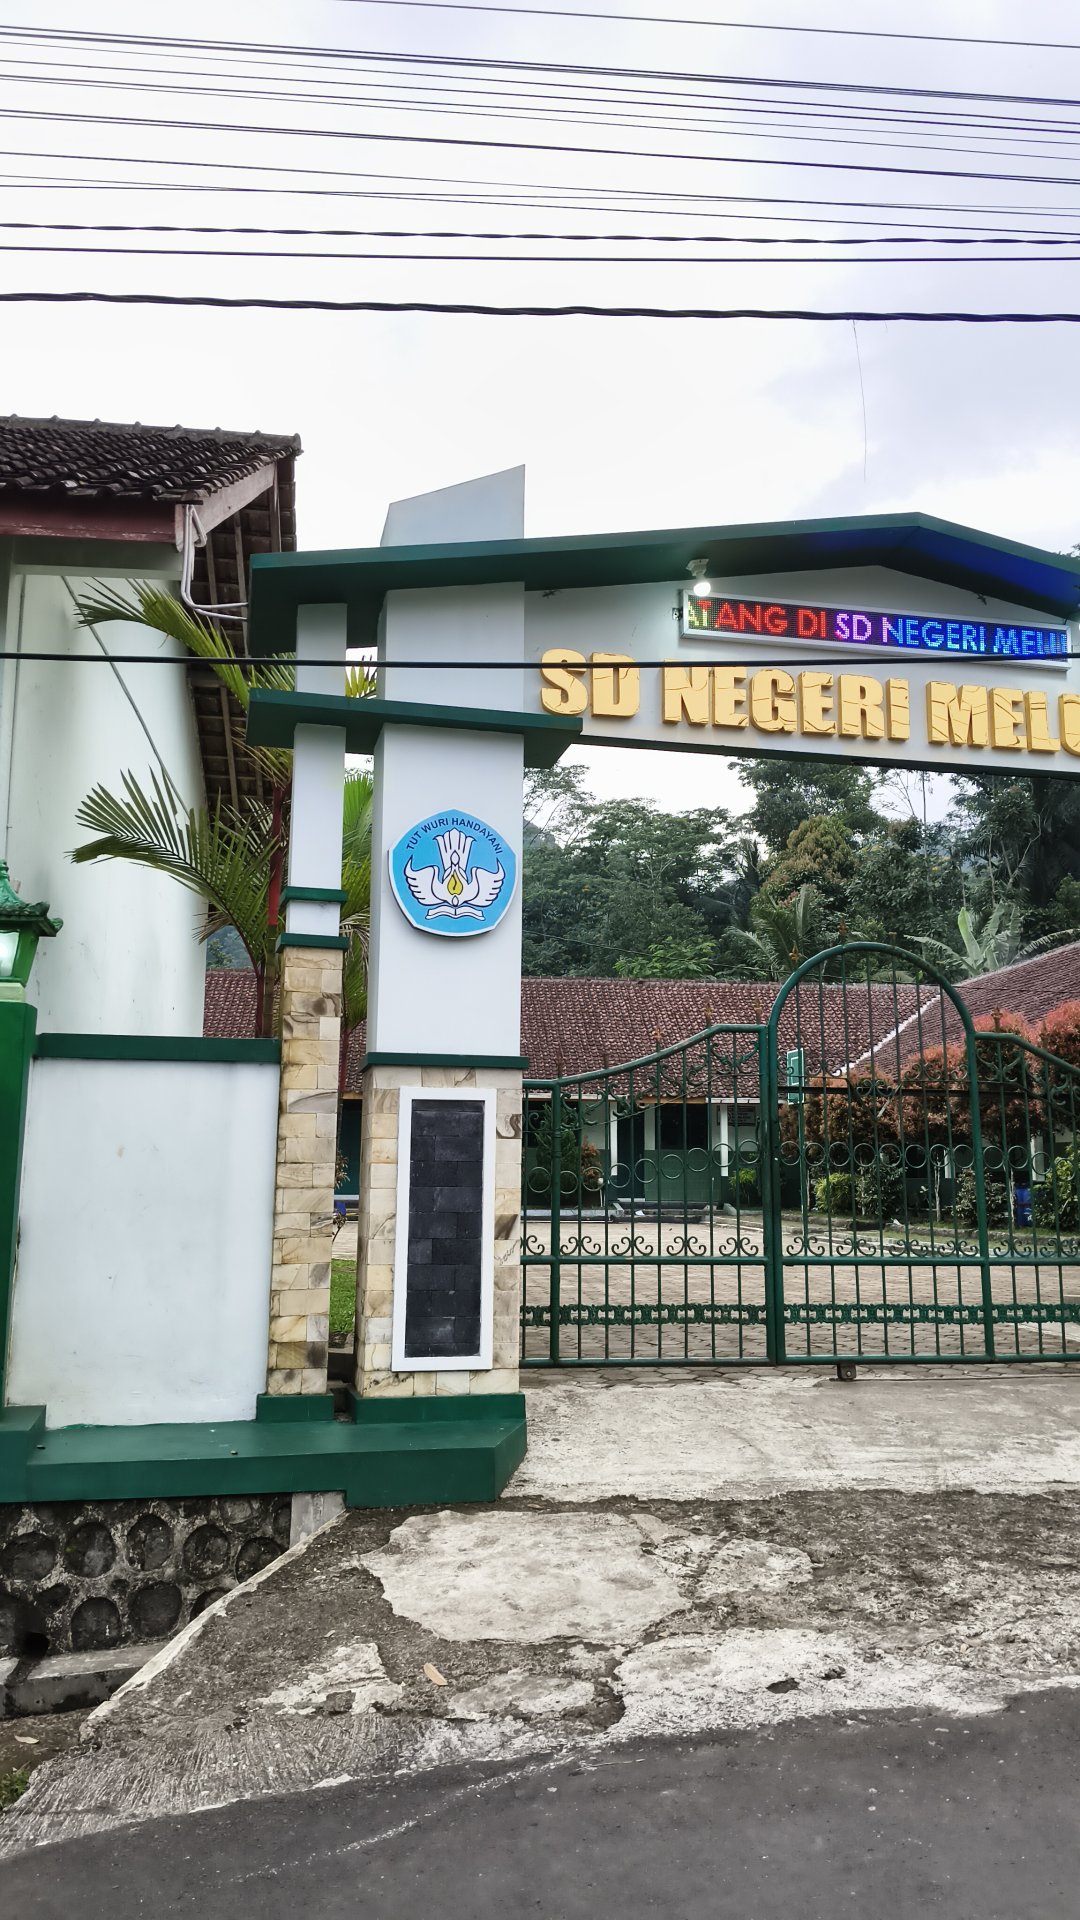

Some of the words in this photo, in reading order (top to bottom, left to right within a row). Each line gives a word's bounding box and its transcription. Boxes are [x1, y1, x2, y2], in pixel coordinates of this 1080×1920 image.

[797, 609, 827, 638] DI
[835, 613, 872, 641] SD
[882, 616, 987, 652] NEGERI
[541, 648, 640, 718] SD
[662, 658, 911, 741] NEGERI
[406, 831, 422, 850] TUT
[421, 818, 449, 833] WURI
[451, 817, 503, 855] HANDAYANI
